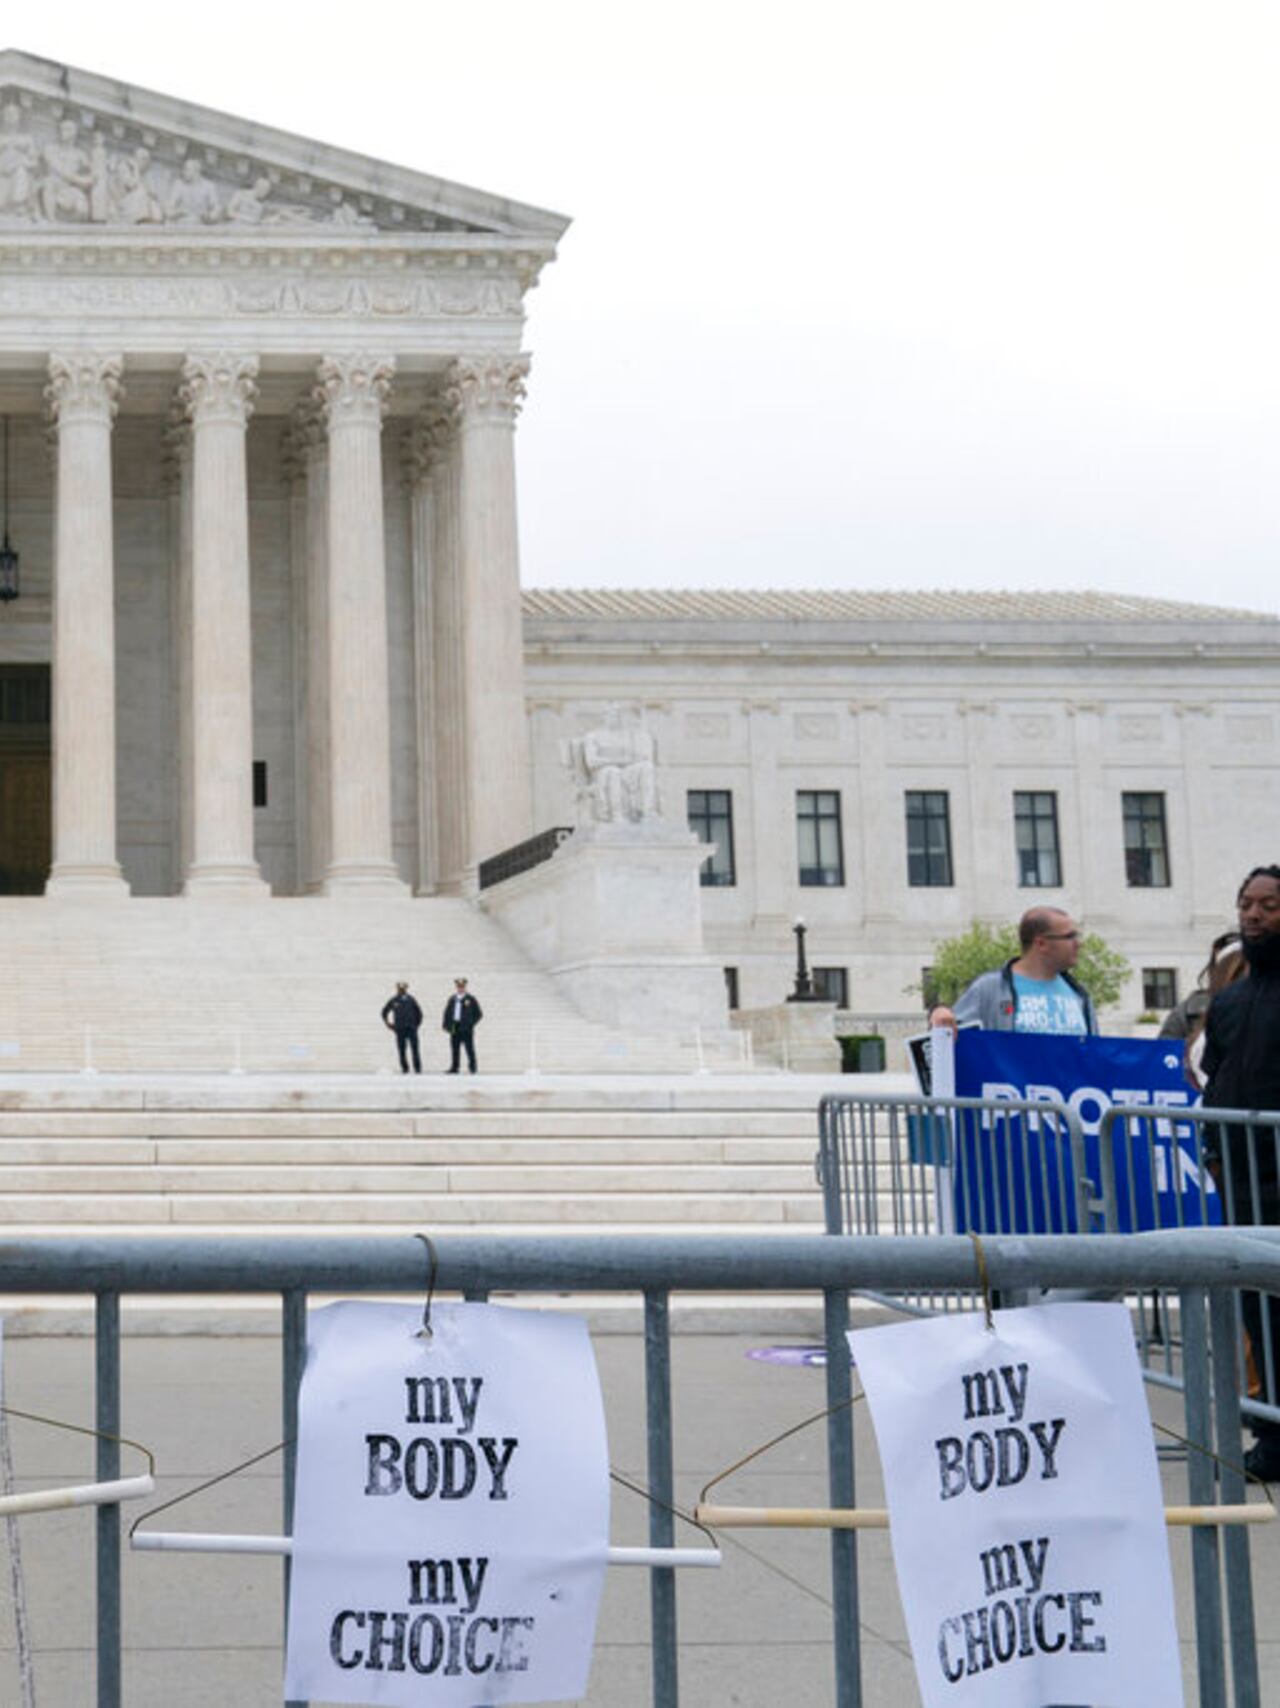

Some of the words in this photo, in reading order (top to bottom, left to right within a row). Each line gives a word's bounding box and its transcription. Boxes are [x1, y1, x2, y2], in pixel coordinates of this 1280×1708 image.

[981, 1082, 1205, 1139] PROTE
[404, 1376, 484, 1435] my
[961, 1362, 1030, 1423] my
[364, 1433, 519, 1501] BODY
[934, 1418, 1066, 1501] BODY
[407, 1557, 489, 1614] my
[979, 1536, 1050, 1597] my
[329, 1609, 535, 1677] CHOICE
[937, 1591, 1107, 1684] CHOICE
